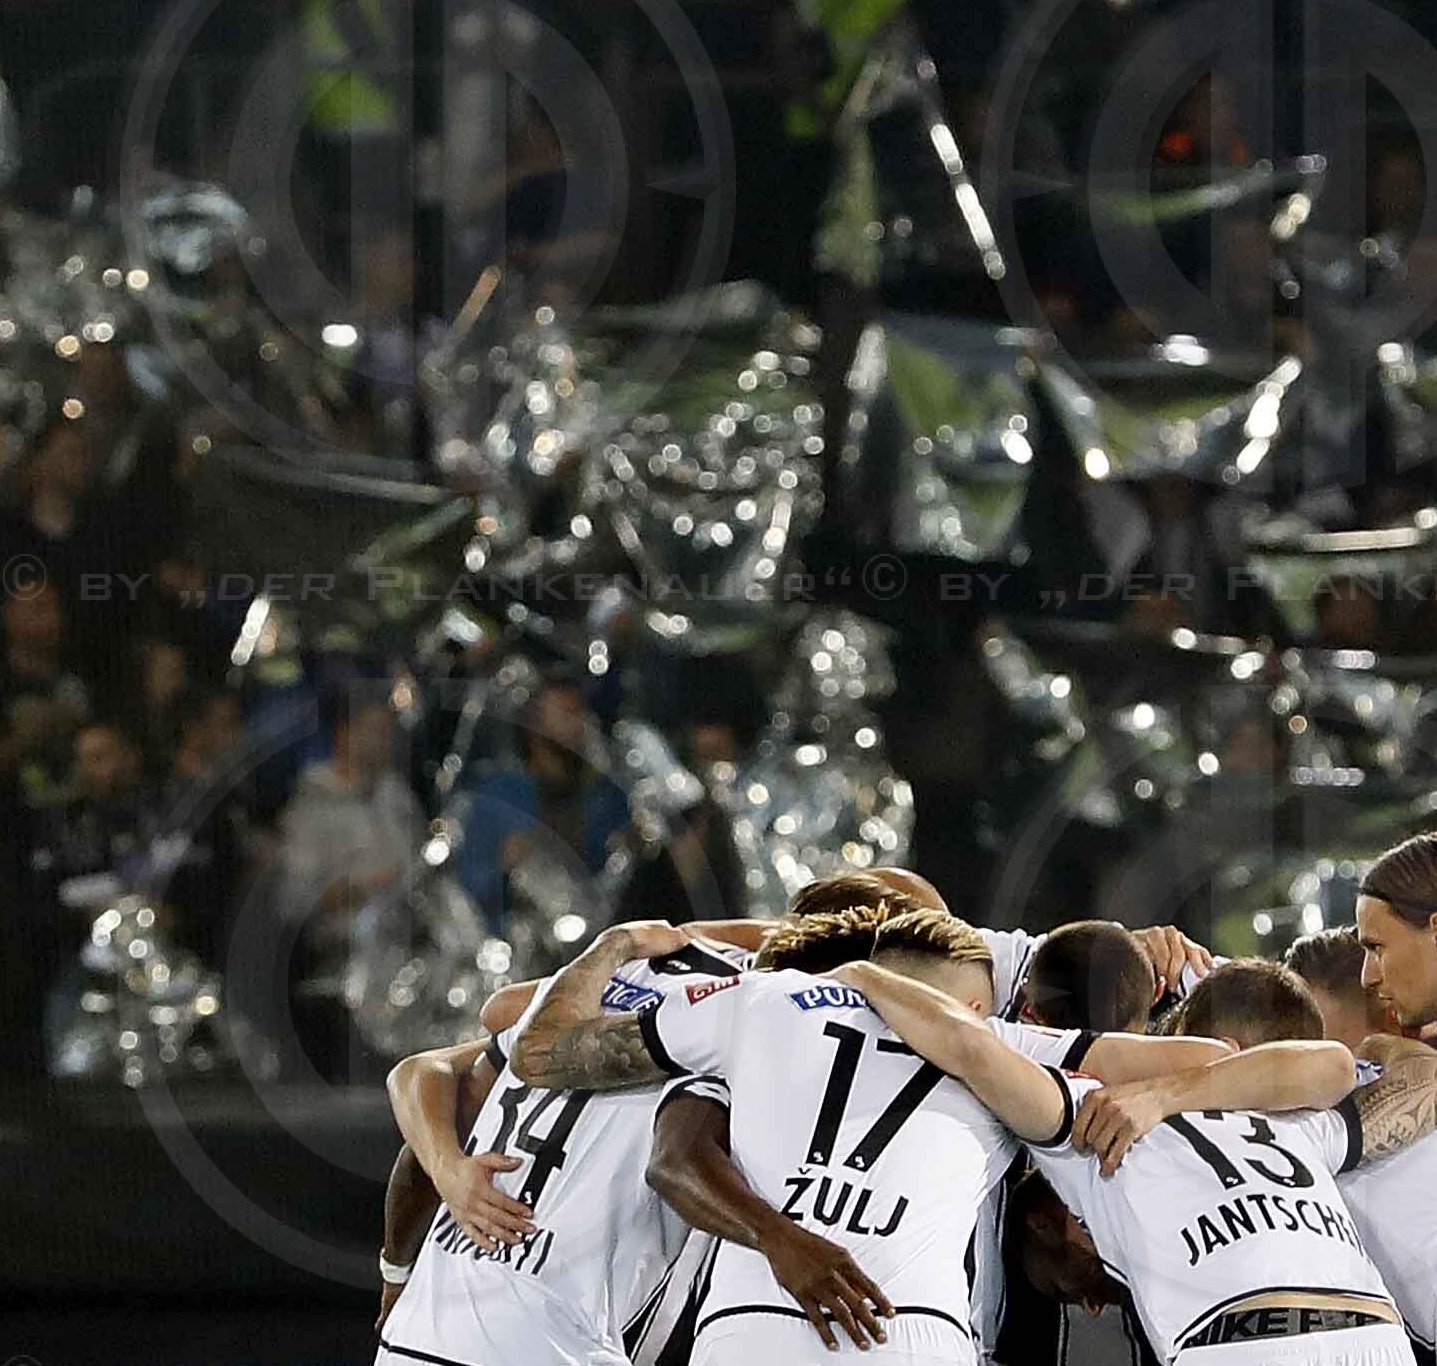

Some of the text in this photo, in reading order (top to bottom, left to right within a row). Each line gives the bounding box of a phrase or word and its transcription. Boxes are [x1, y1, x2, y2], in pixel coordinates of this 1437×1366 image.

[806, 1020, 950, 1172] 17
[1162, 1110, 1315, 1190] 13
[781, 1166, 909, 1237] ŽULJ
